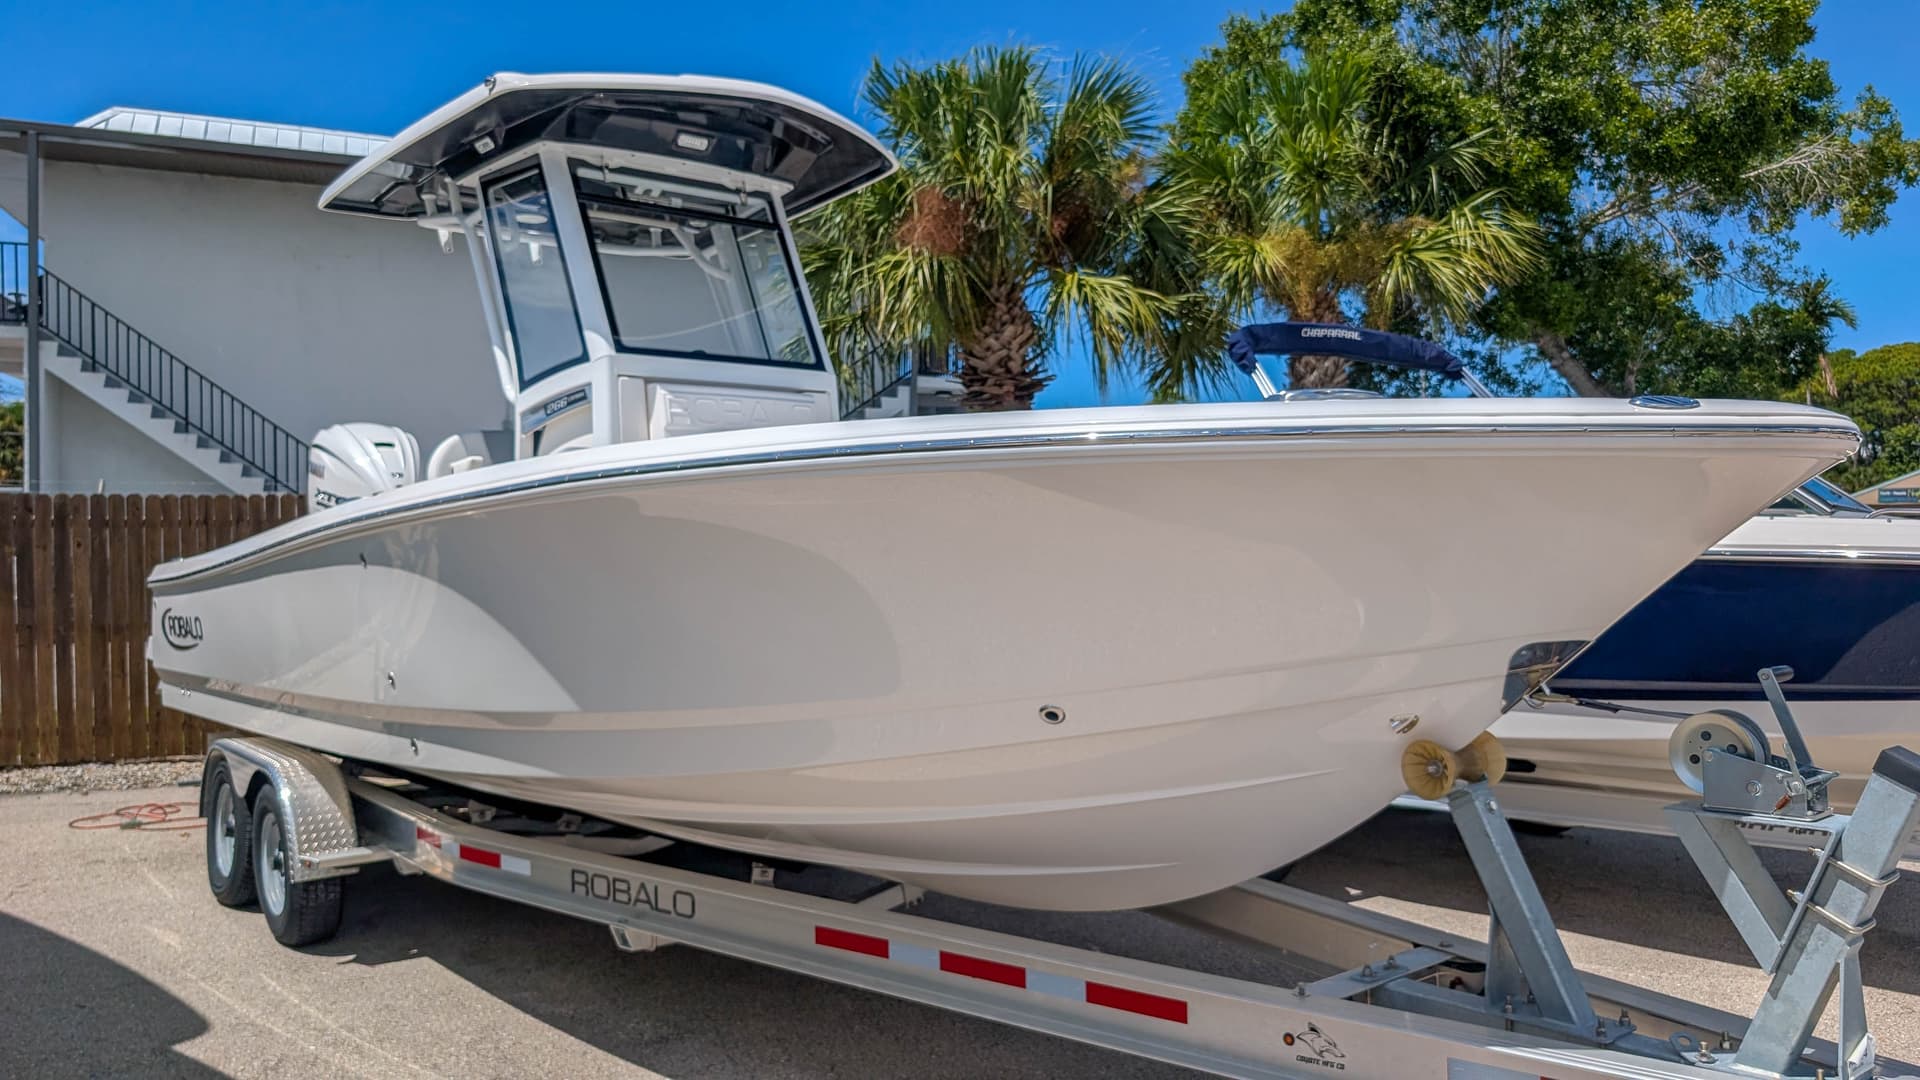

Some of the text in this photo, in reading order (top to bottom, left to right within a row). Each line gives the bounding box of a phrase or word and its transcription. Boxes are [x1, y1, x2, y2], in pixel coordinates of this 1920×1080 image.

[1301, 327, 1362, 341] CHAPARRAL
[168, 615, 204, 640] ROBALO
[571, 868, 695, 919] ROBALO
